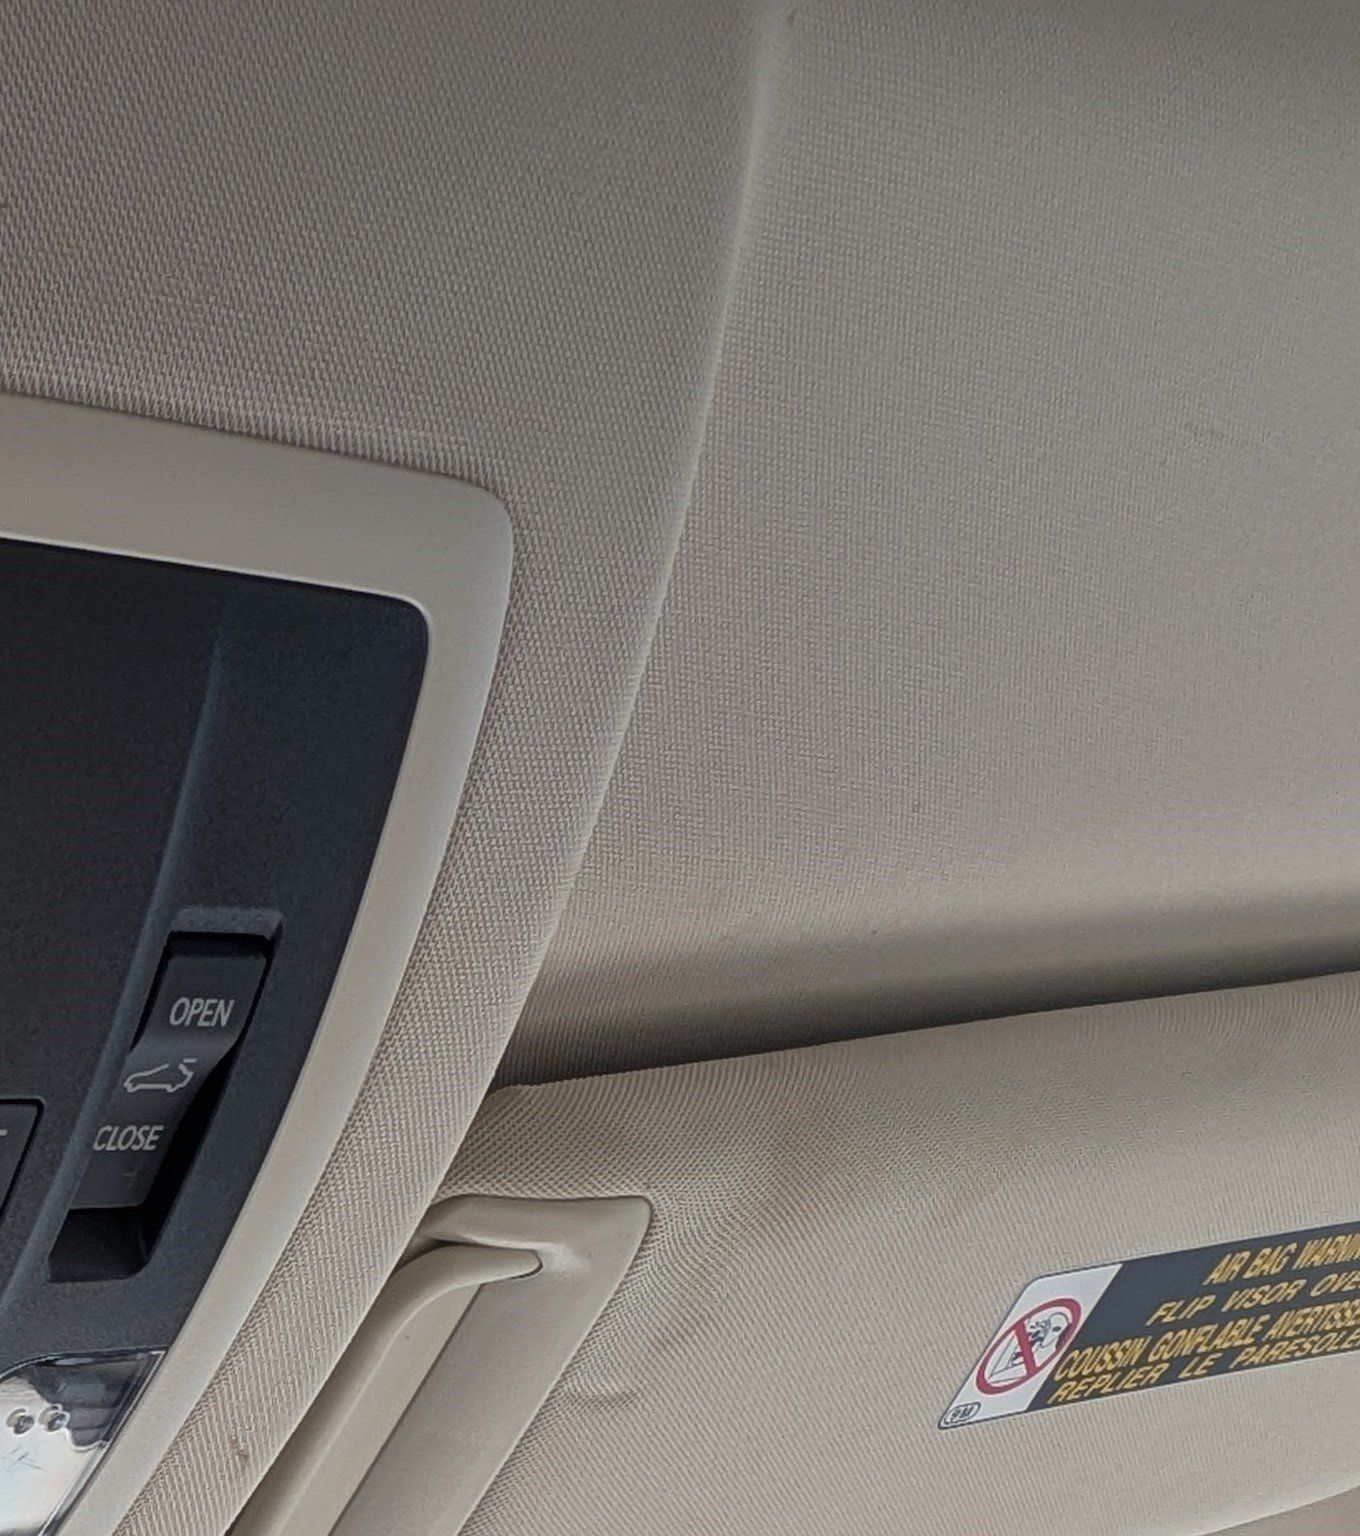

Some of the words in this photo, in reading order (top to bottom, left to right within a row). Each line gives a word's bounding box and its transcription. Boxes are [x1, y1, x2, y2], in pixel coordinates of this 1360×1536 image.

[169, 996, 235, 1028] OPEN
[92, 1124, 165, 1152] CLOSE
[1202, 1250, 1252, 1286] AIR
[1242, 1242, 1298, 1279] BAG
[1145, 1294, 1216, 1327] FLIP
[1221, 1278, 1308, 1313] VISOR
[1054, 1335, 1153, 1382] COUSSIN
[1148, 1313, 1272, 1363] GONFLABLE
[1046, 1362, 1170, 1404] REPLIER
[1178, 1352, 1224, 1379] LE
